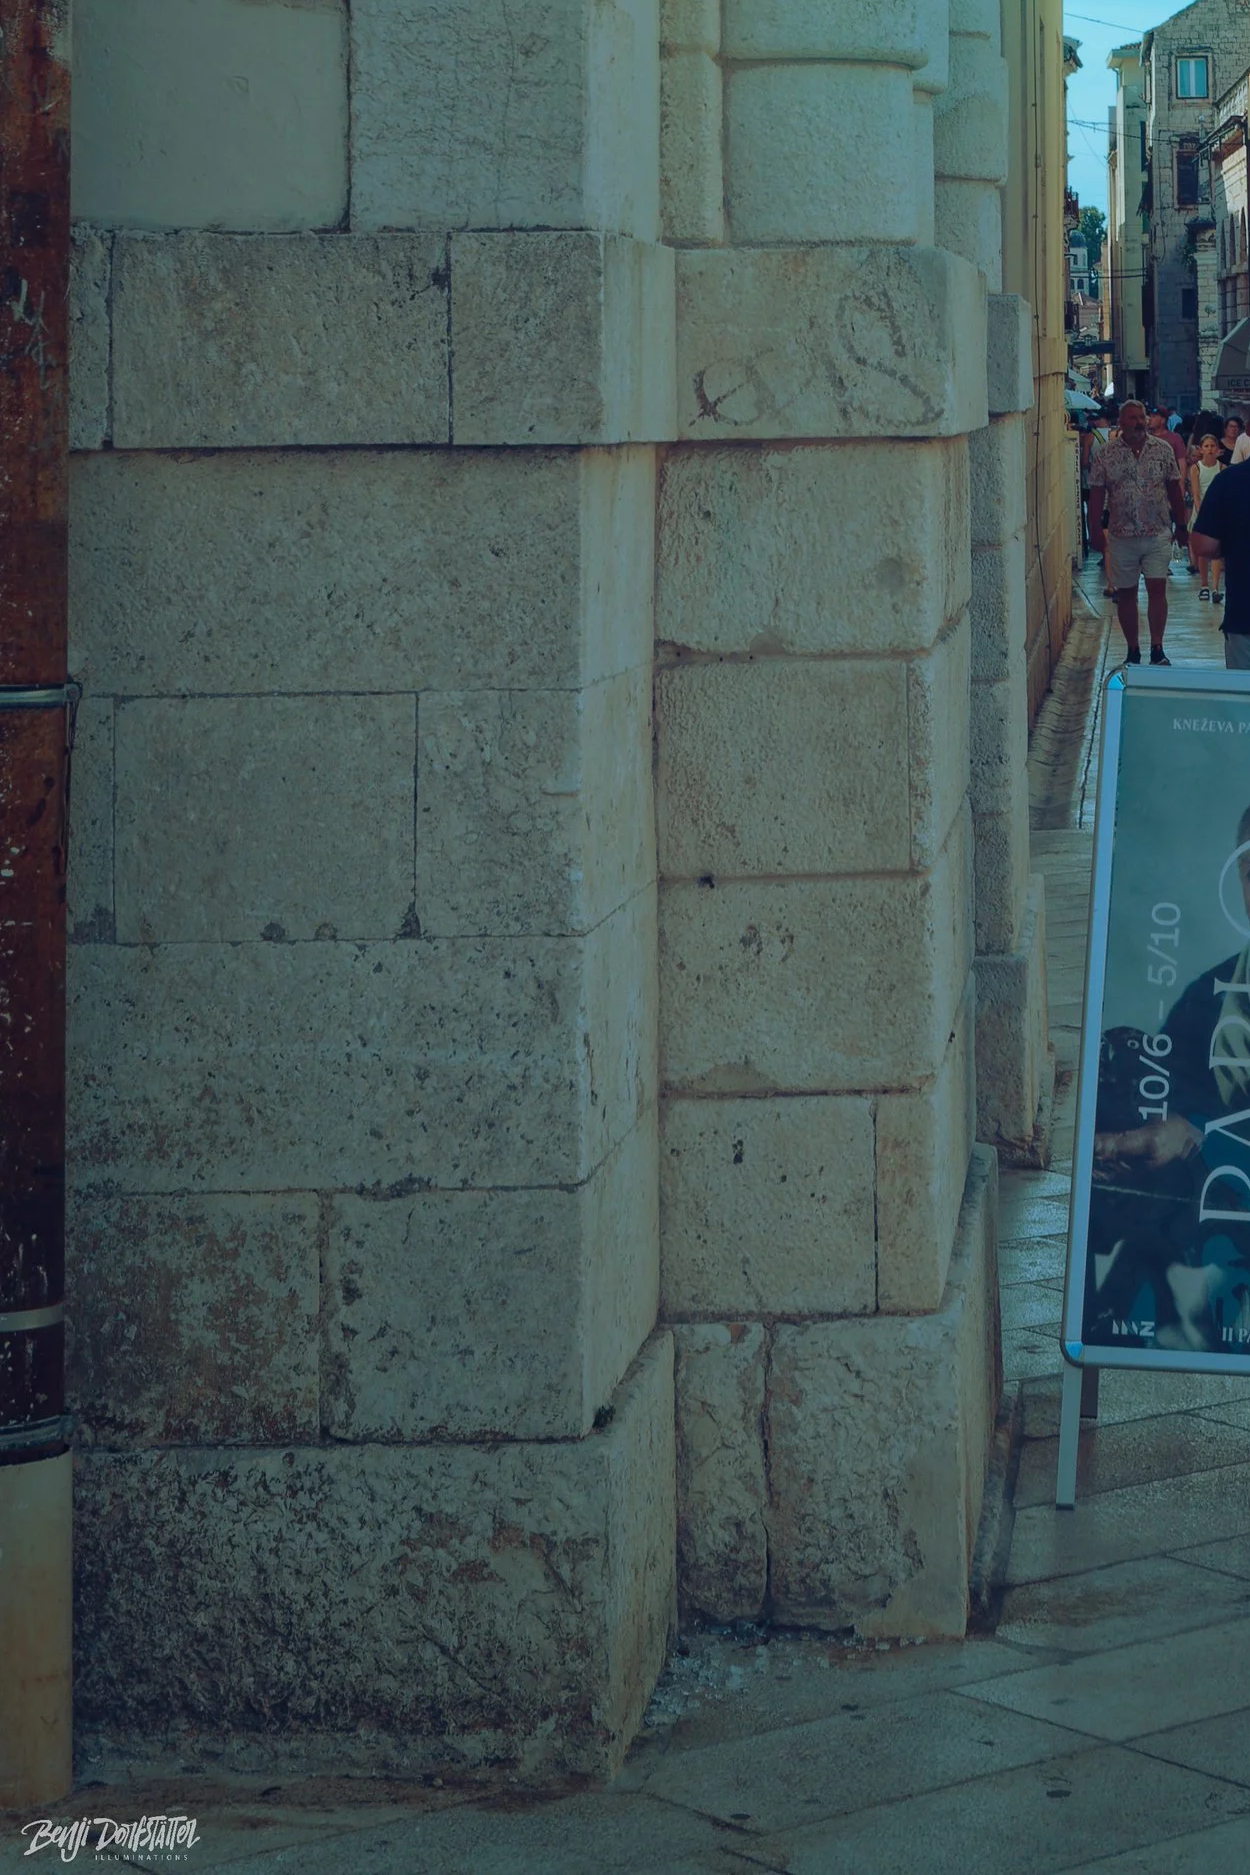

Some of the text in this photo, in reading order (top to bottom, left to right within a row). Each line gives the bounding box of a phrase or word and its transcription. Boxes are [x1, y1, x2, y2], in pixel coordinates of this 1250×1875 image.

[1227, 379, 1241, 387] ICE
[1172, 717, 1234, 734] KNEŽEVA
[1148, 901, 1181, 988] 5/10
[1138, 1032, 1173, 1122] 10/6
